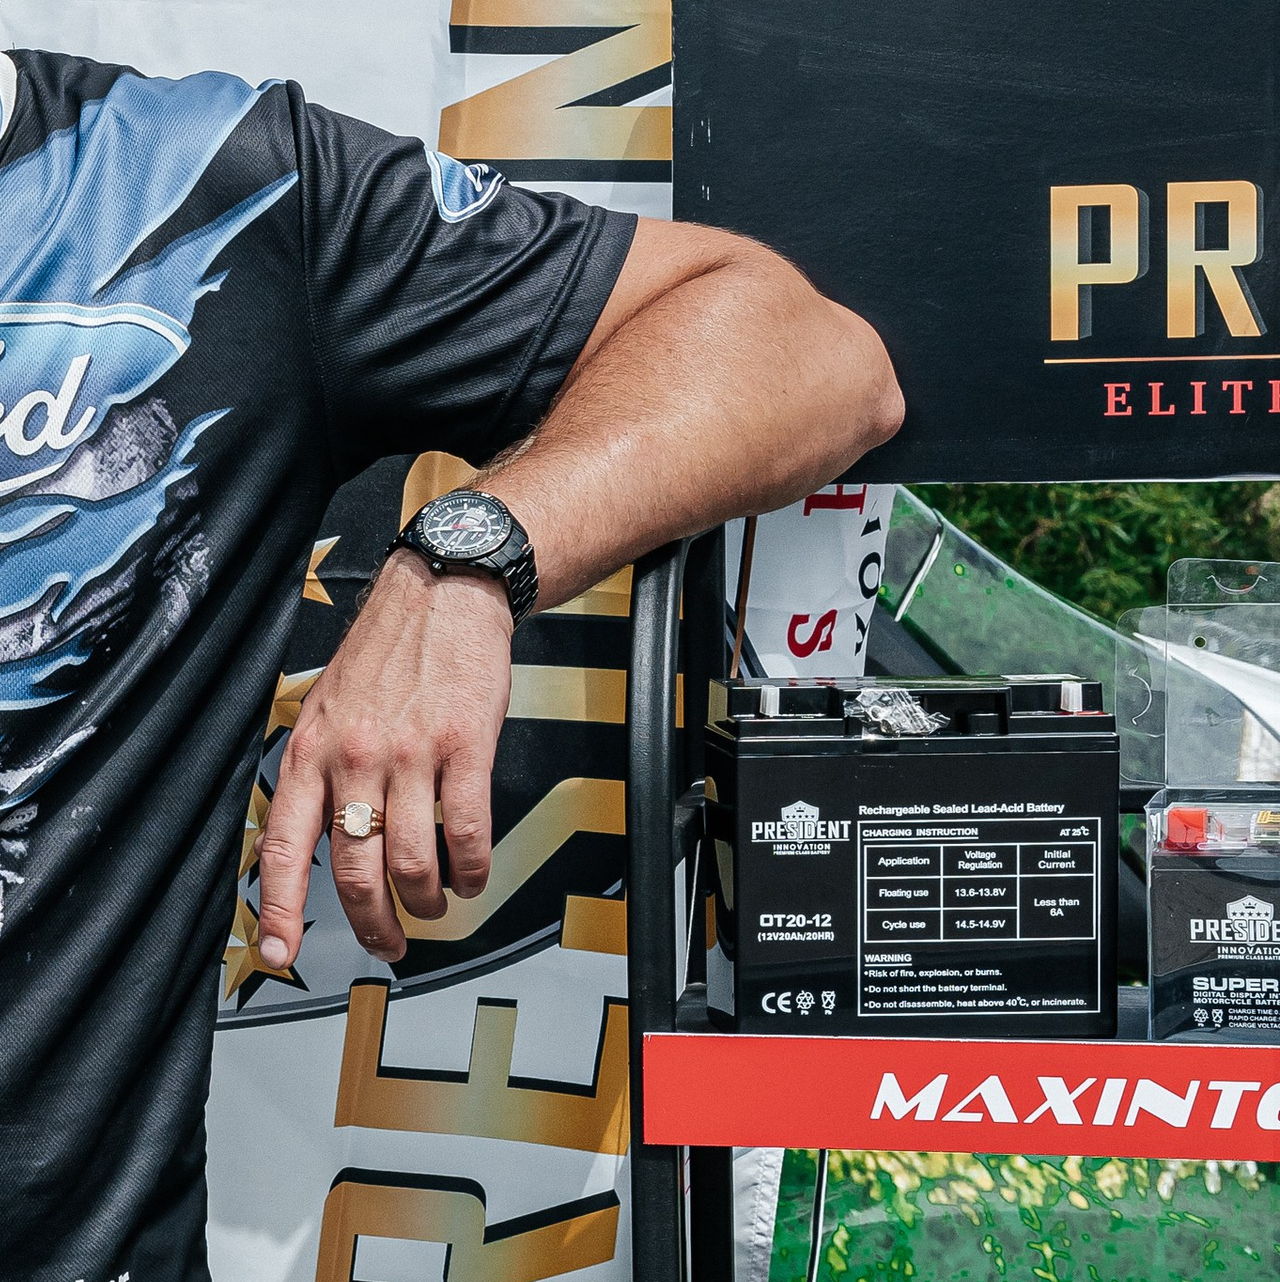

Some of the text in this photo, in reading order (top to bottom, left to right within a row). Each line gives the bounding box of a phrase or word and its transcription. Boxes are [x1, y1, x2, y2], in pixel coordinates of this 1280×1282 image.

[1049, 179, 1268, 342] PR
[1103, 379, 1280, 416] ELIT
[858, 802, 1065, 816] Rechargeable Sealed Lead-Acid Battery
[751, 820, 852, 840] PRESIDENT
[862, 827, 979, 837] CHARGING INSTRUCTION
[1059, 828, 1070, 837] AT
[773, 843, 831, 851] INNOVATION
[964, 850, 997, 860] Voltage
[1044, 850, 1071, 859] Initial
[878, 856, 930, 867] Application
[958, 860, 1003, 870] Regulation
[1038, 860, 1076, 869] Current
[879, 888, 912, 898] Floating
[954, 888, 1007, 897] 13.6-13.8V
[1034, 897, 1080, 907] Less than
[1049, 908, 1064, 917] 6A
[759, 913, 832, 928] OT20-12
[882, 920, 926, 930] Cycle use
[954, 919, 1006, 929] 14.5-14.9V
[757, 931, 835, 942] (12V20Ah/20HR)
[864, 953, 912, 963] WARNING
[868, 968, 1003, 979] Risk of fire, explosion, or burns.
[868, 983, 1008, 994] Do not short the battery terminal.
[1192, 976, 1279, 992] SUPER
[868, 1000, 881, 1009] Do
[882, 1000, 897, 1008] not
[898, 999, 955, 1009] disassemble,
[956, 999, 977, 1007] heat
[977, 999, 1004, 1007] above
[1031, 999, 1041, 1007] or
[1041, 997, 1088, 1007] incinerate.
[1193, 997, 1252, 1005] MOTORCYCLE
